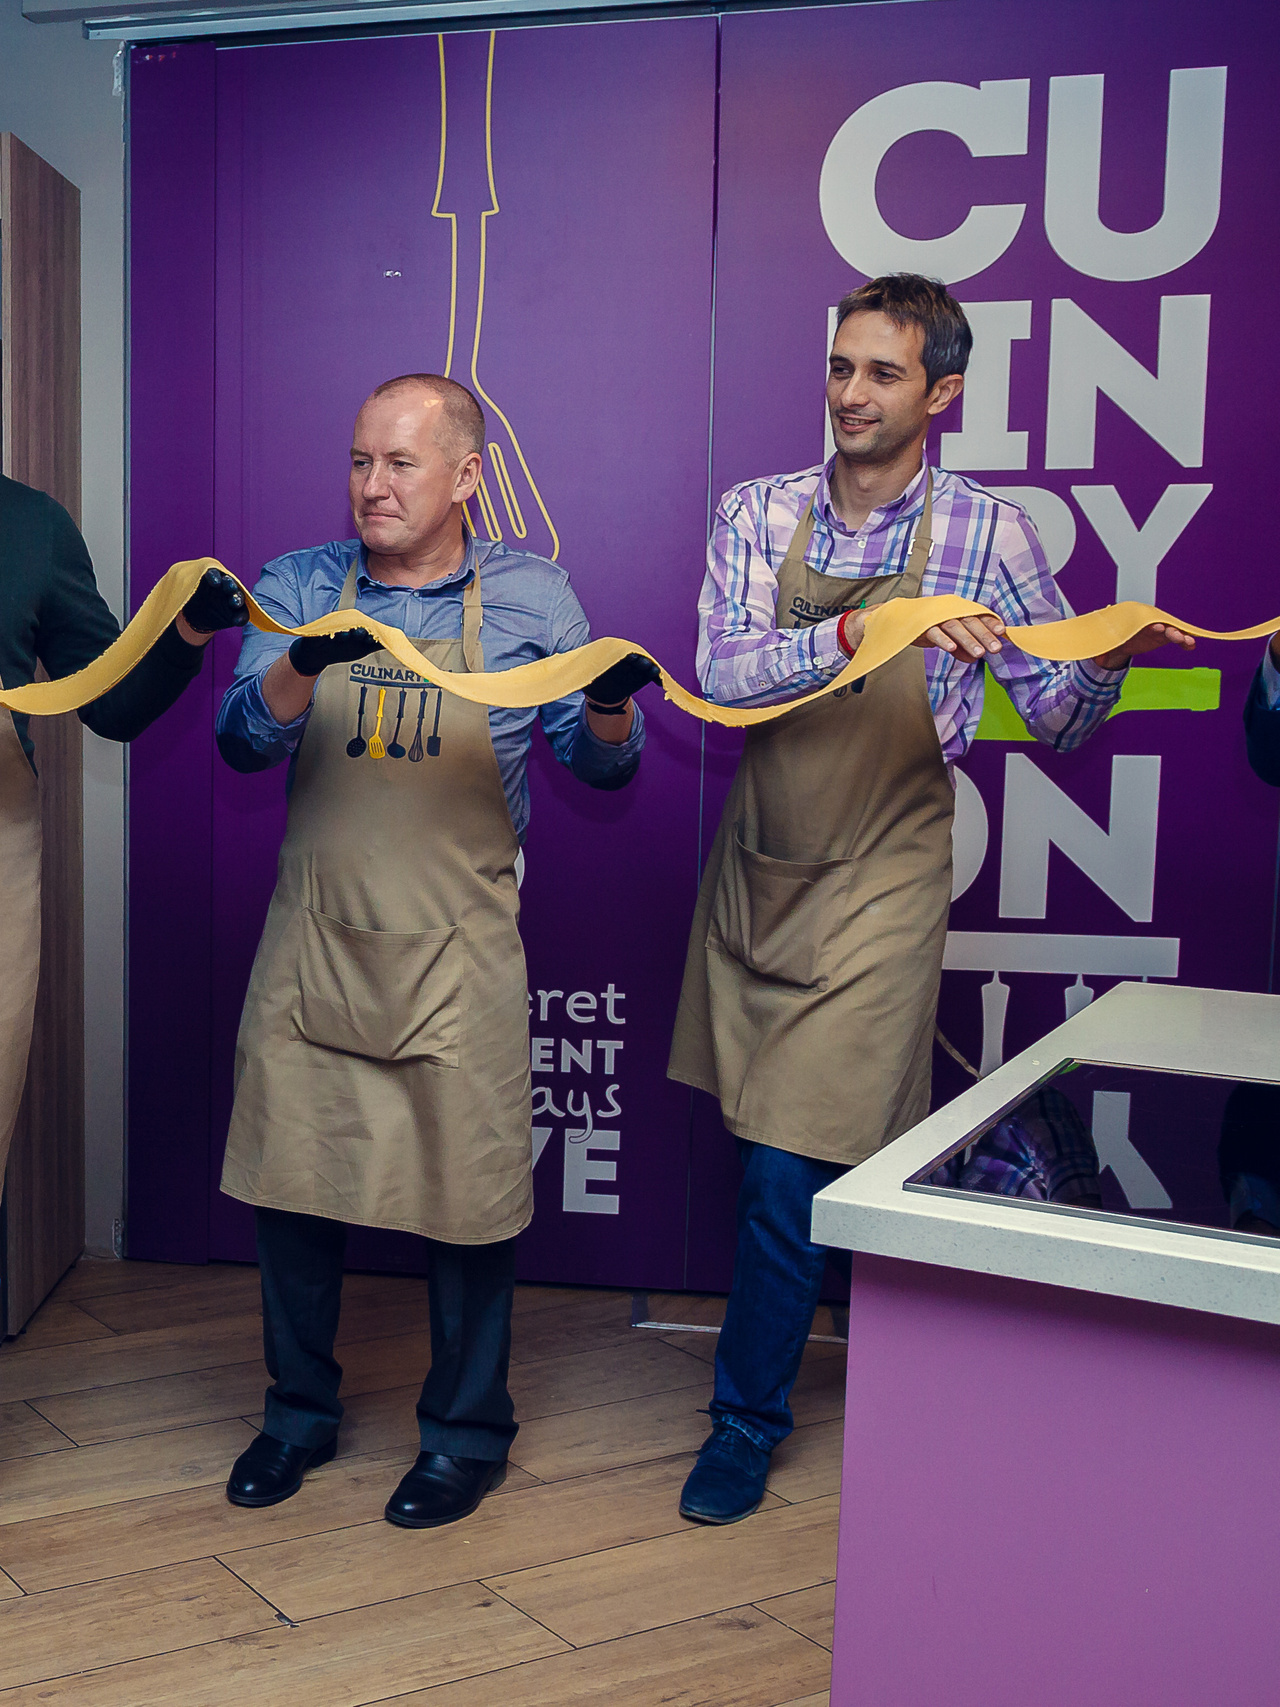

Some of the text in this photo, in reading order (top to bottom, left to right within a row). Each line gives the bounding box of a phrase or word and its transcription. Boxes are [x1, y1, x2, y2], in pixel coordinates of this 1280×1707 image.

[819, 66, 1228, 285] CU
[824, 294, 1212, 473] IN
[528, 983, 627, 1024] ret
